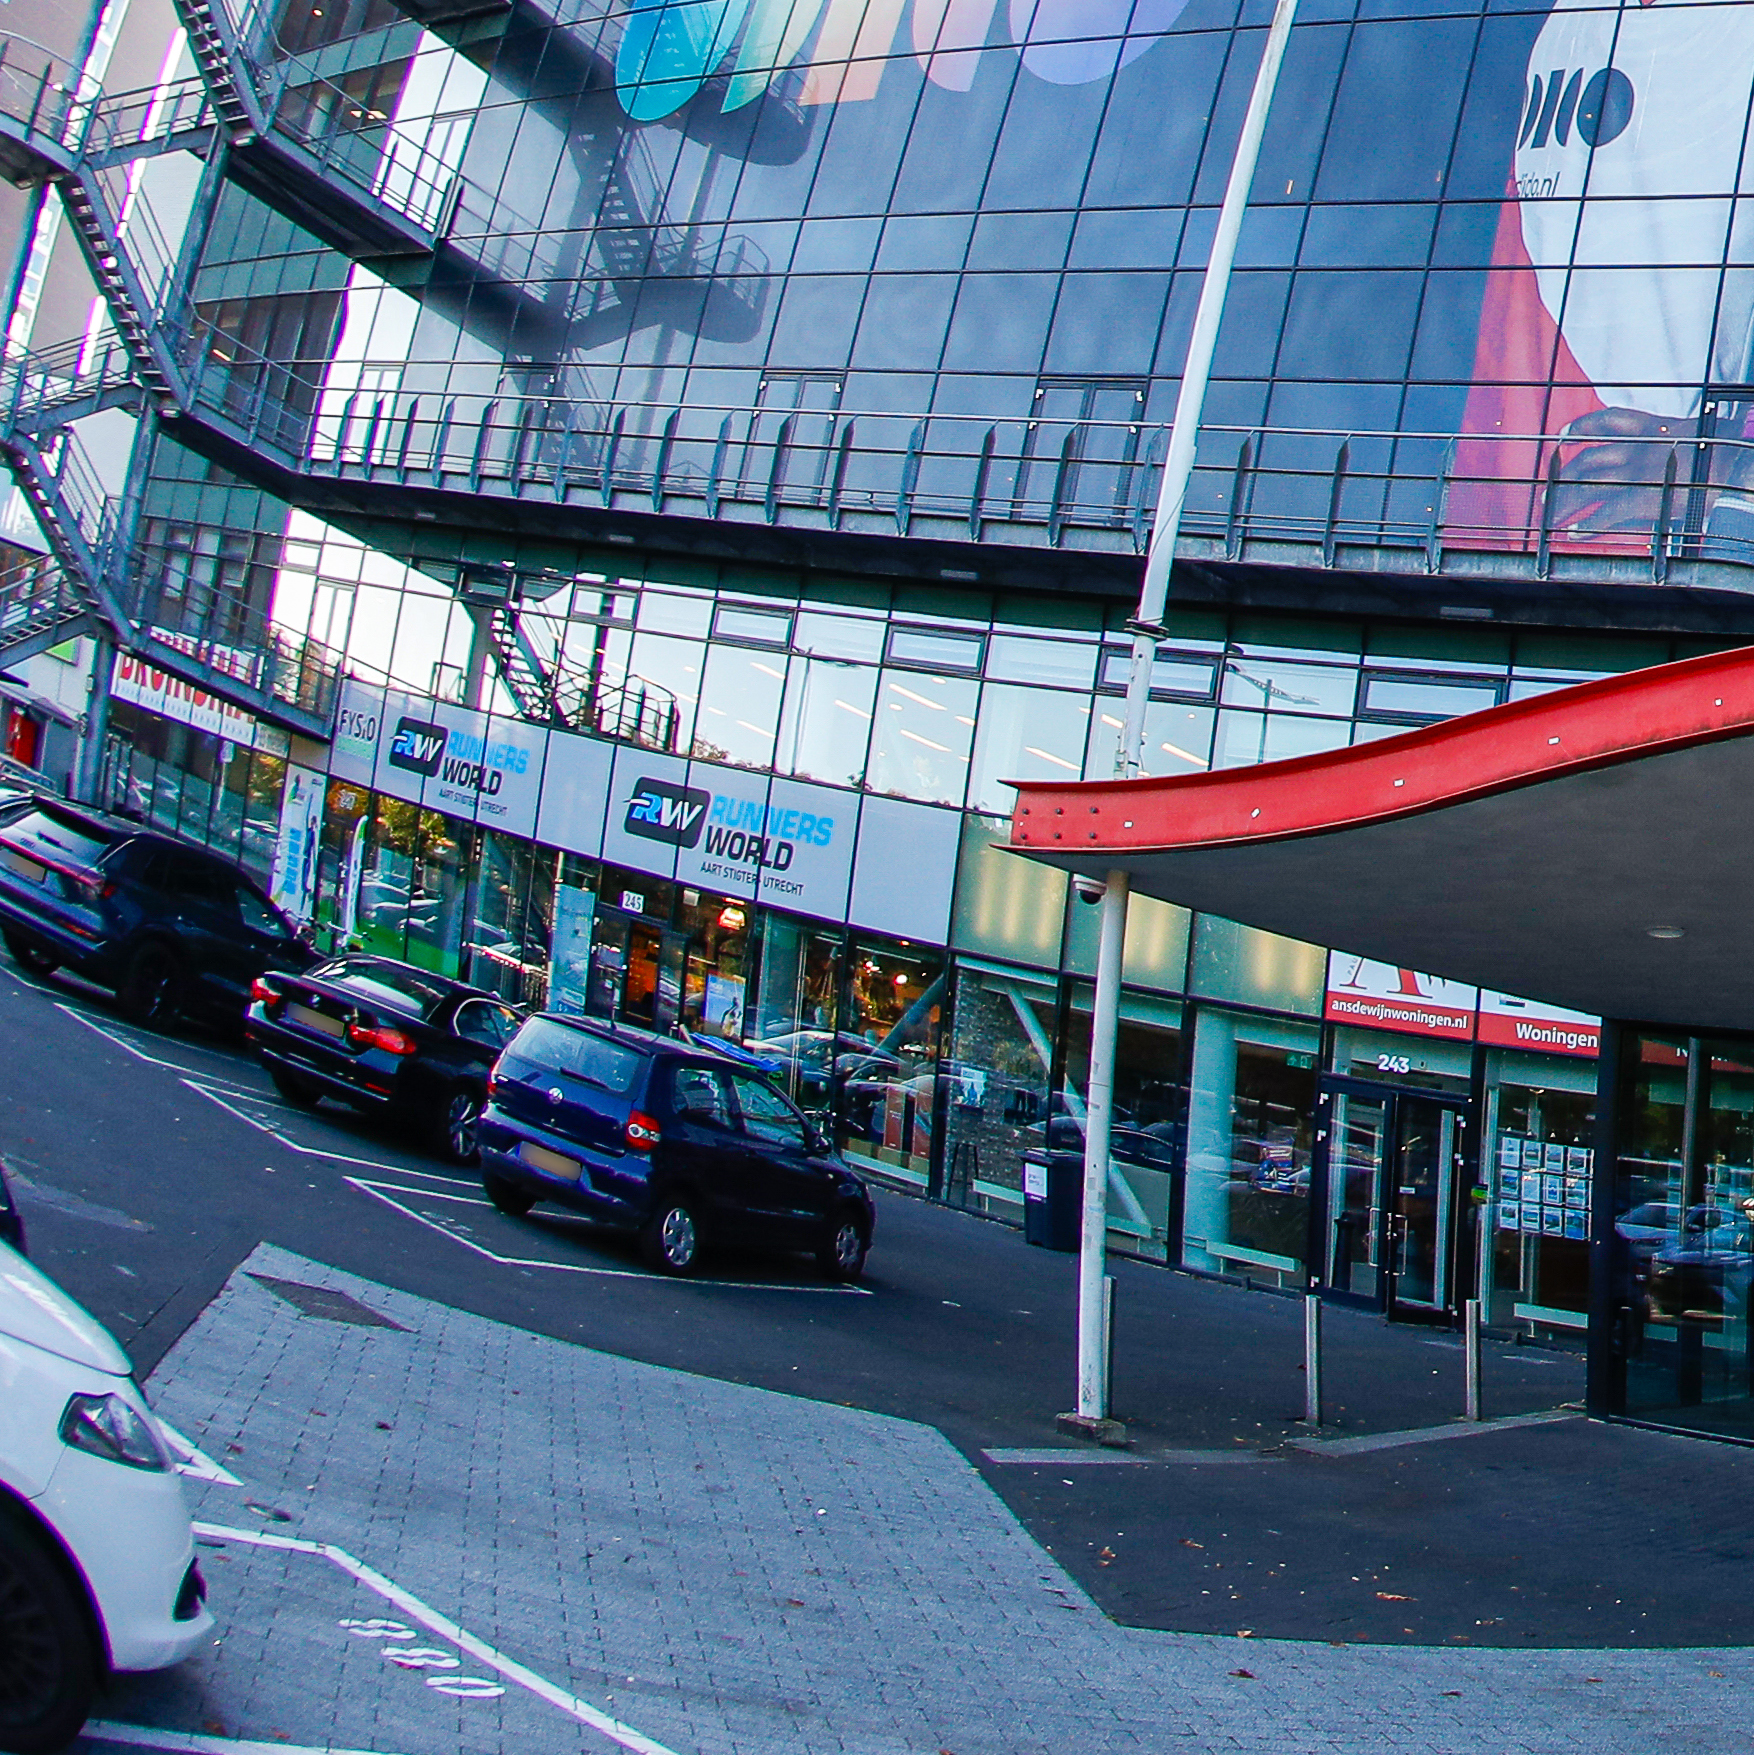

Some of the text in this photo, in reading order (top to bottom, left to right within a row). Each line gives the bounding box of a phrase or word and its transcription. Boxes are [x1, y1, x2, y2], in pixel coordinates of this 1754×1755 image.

[448, 731, 530, 774] RUNNERS
[442, 757, 502, 796] WORLD
[710, 795, 834, 846] RUNNERS
[705, 825, 793, 871] WORLD
[701, 862, 804, 896] AART STIGTER UTRECHT
[624, 894, 642, 910] 245
[1332, 1000, 1468, 1029] ansdewijnwoningen.nl
[1516, 1022, 1599, 1049] Woningen
[1377, 1054, 1410, 1074] 243
